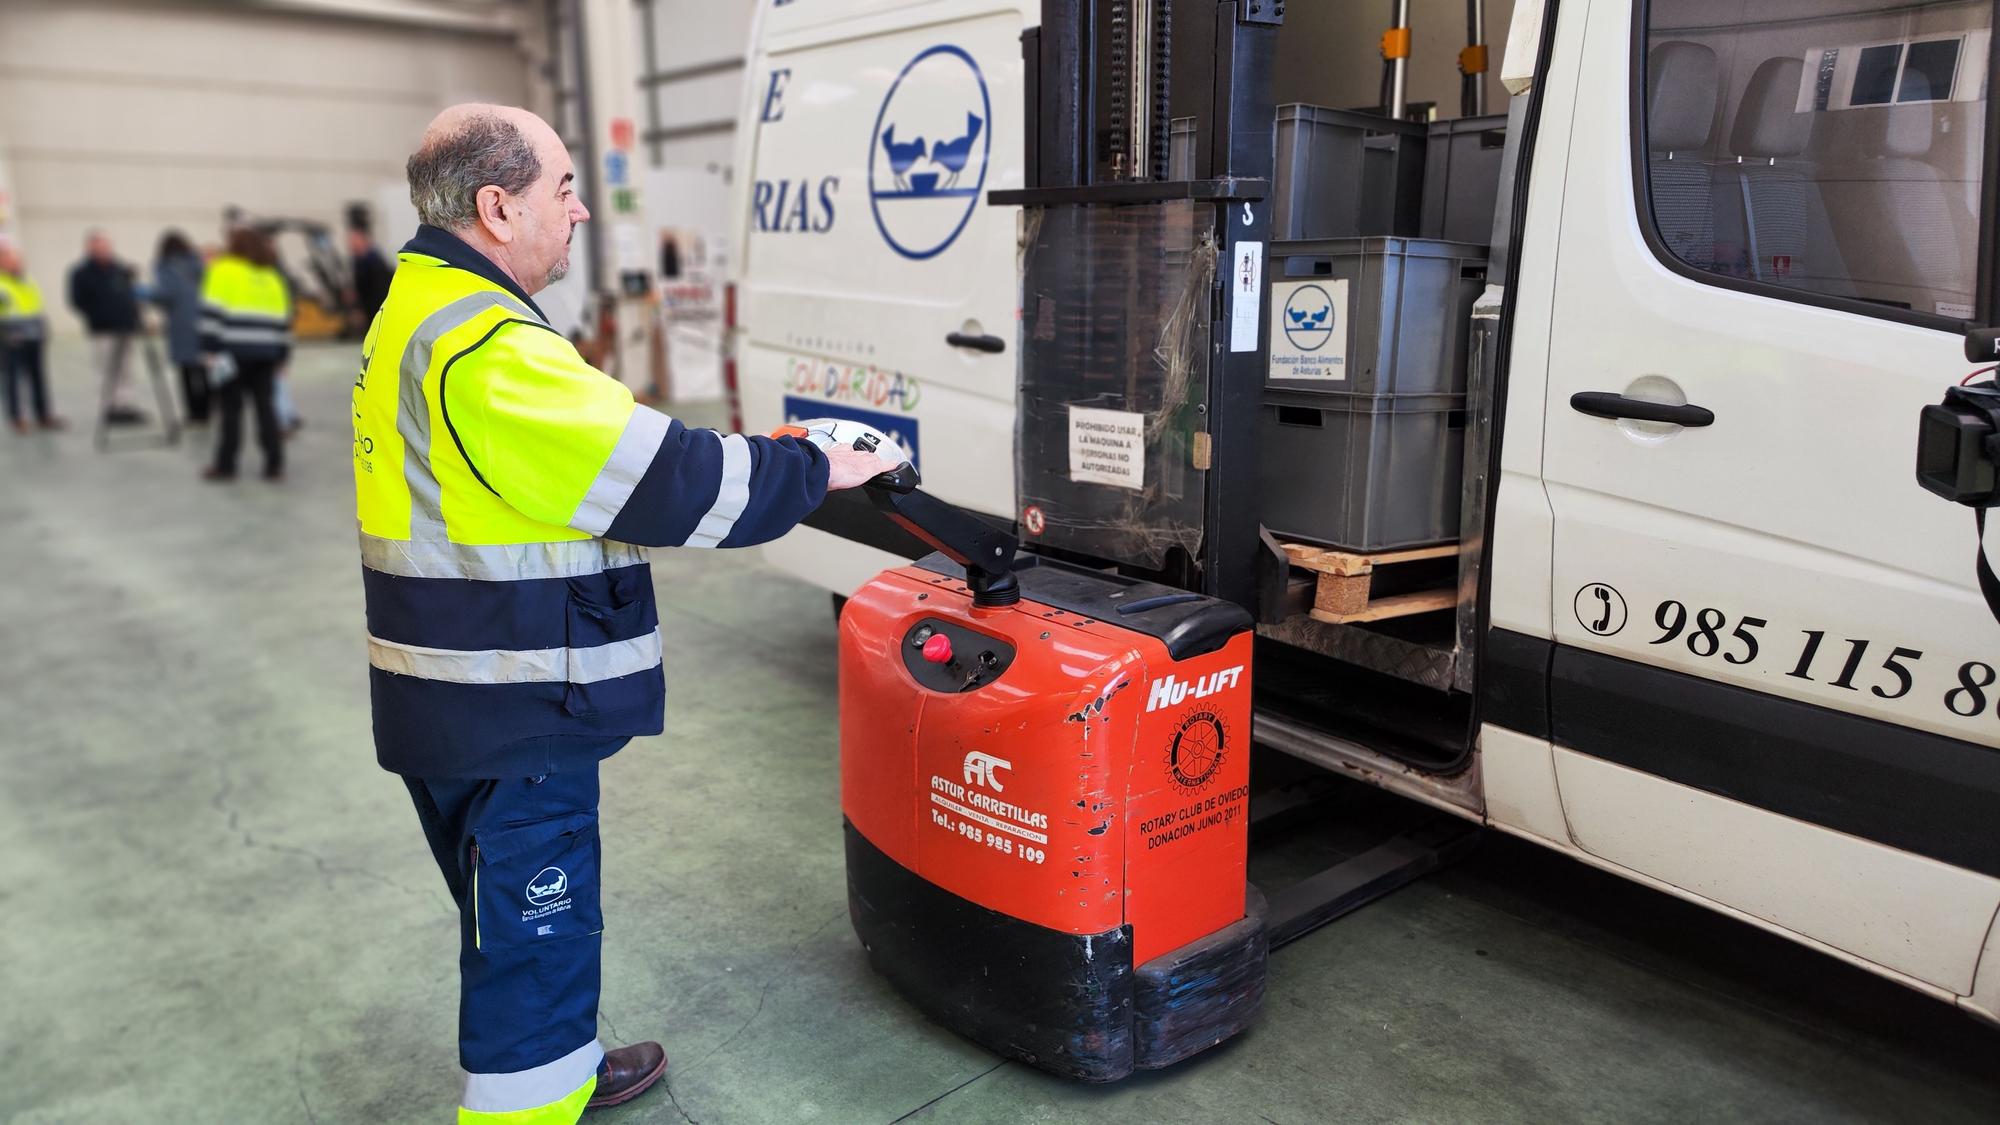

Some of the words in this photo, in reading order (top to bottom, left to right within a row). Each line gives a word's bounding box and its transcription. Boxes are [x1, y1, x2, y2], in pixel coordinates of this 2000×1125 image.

[1075, 421, 1116, 433] PROHIBIDO
[1078, 435, 1089, 444] LA
[1089, 436, 1124, 448] MAQUINA
[1125, 441, 1132, 449] A
[1081, 462, 1130, 476] AUTORIZADAS
[1118, 453, 1130, 463] NO
[1648, 599, 1768, 665] 985
[1785, 629, 1924, 699] 115
[1943, 661, 2000, 720] 8
[1184, 713, 1213, 729] ROTARY
[931, 775, 965, 802] ASTUR
[967, 790, 1048, 829] CARRETILLAS
[1140, 811, 1177, 836] ROTARY
[1179, 802, 1203, 821] CLUB
[1204, 797, 1216, 812] DE
[1217, 785, 1249, 807] OVIEDO
[934, 796, 963, 812] ALQUILER
[967, 809, 990, 823] VENTA
[995, 821, 1042, 841] REPARACION
[1148, 821, 1195, 850] DONACION
[1197, 811, 1223, 832] JUNIO
[1224, 804, 1241, 821] 2011
[958, 821, 983, 843] 985
[986, 833, 1012, 854] 985
[1017, 844, 1045, 864] 109
[522, 898, 571, 915] VOLUNTARIO
